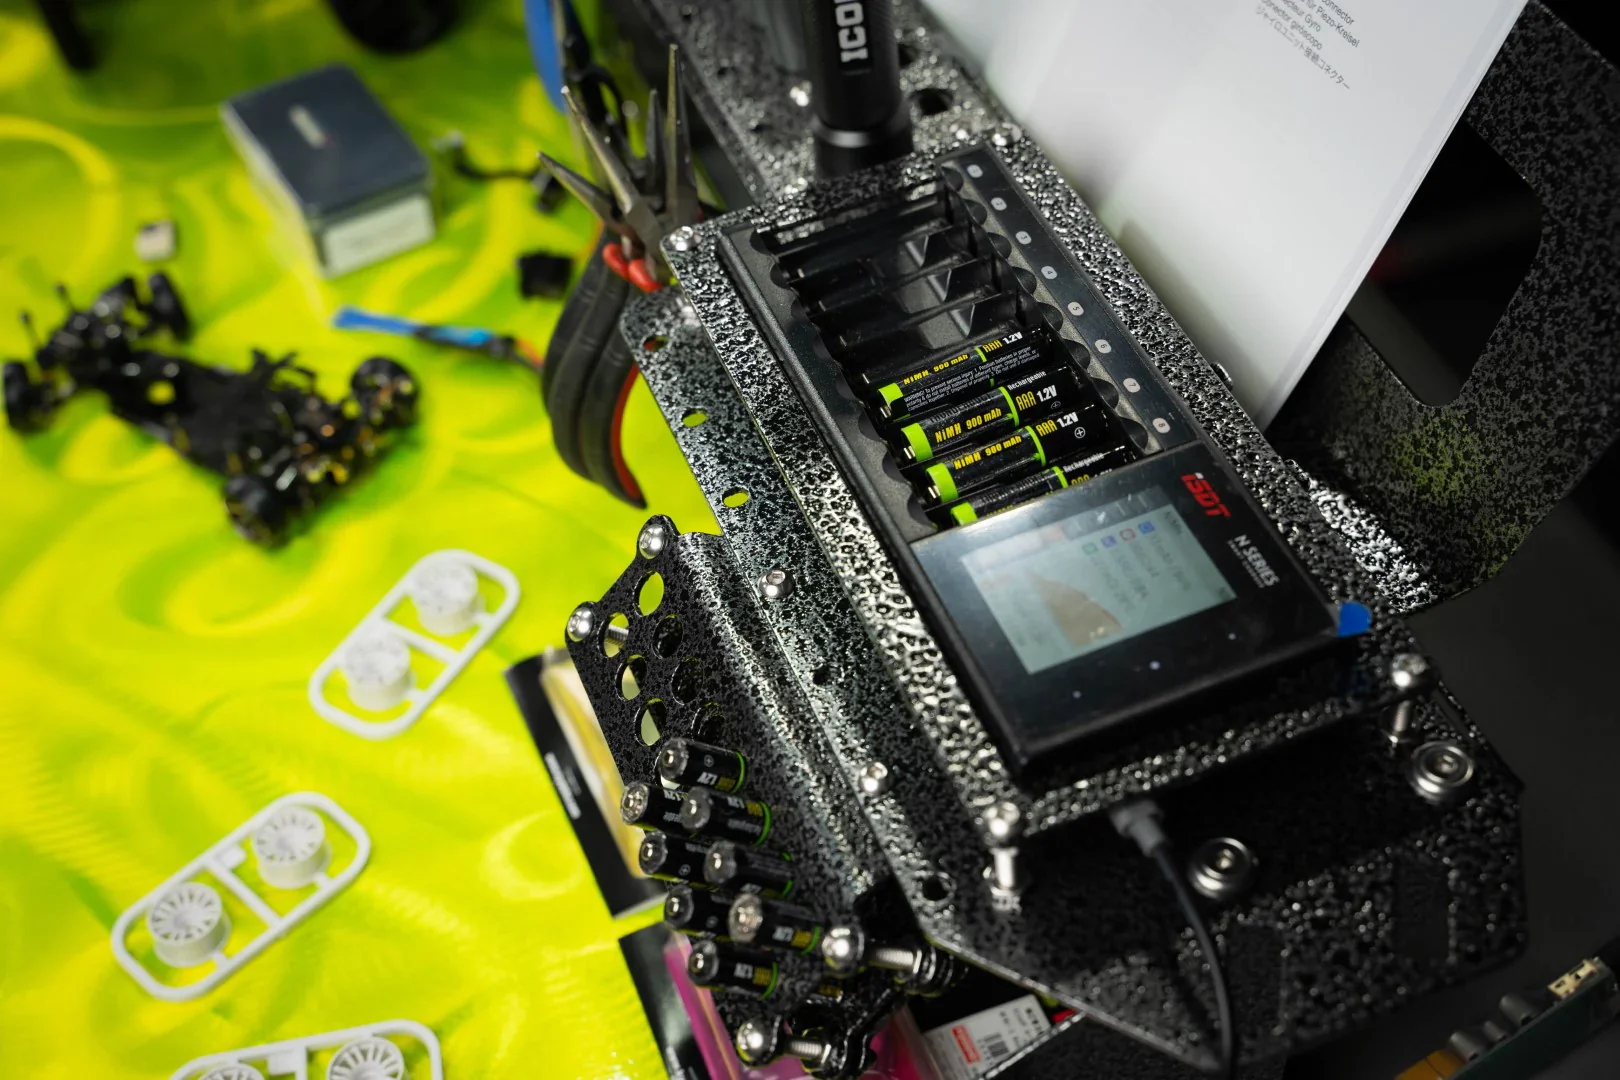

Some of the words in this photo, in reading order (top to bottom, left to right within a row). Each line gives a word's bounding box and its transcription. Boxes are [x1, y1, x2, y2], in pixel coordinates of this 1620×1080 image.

[835, 0, 868, 62] ICO
[1304, 14, 1322, 32] Gyro
[1316, 6, 1360, 48] Piezo-Kreisel
[982, 340, 1002, 353] AAA
[1002, 331, 1023, 345] 1.2V
[933, 361, 950, 372] 900
[950, 353, 969, 367] mAh
[995, 354, 1013, 364] batteries
[1018, 346, 1031, 355] proper
[1007, 370, 1047, 391] Rechargeable
[1015, 391, 1036, 411] AAA
[1036, 386, 1057, 403] 1.2V
[935, 424, 962, 444] NiMH
[966, 415, 983, 430] 900
[984, 407, 1002, 424] mAh
[1035, 420, 1057, 437] AAA
[1056, 413, 1079, 428] 1.2V
[954, 450, 981, 470] NiMH
[985, 443, 1003, 458] 900
[1002, 435, 1022, 450] mAh
[1062, 452, 1104, 473] Rechargeable
[1234, 534, 1250, 550] N
[1244, 546, 1280, 588] SERIES
[697, 772, 718, 785] 1.2V
